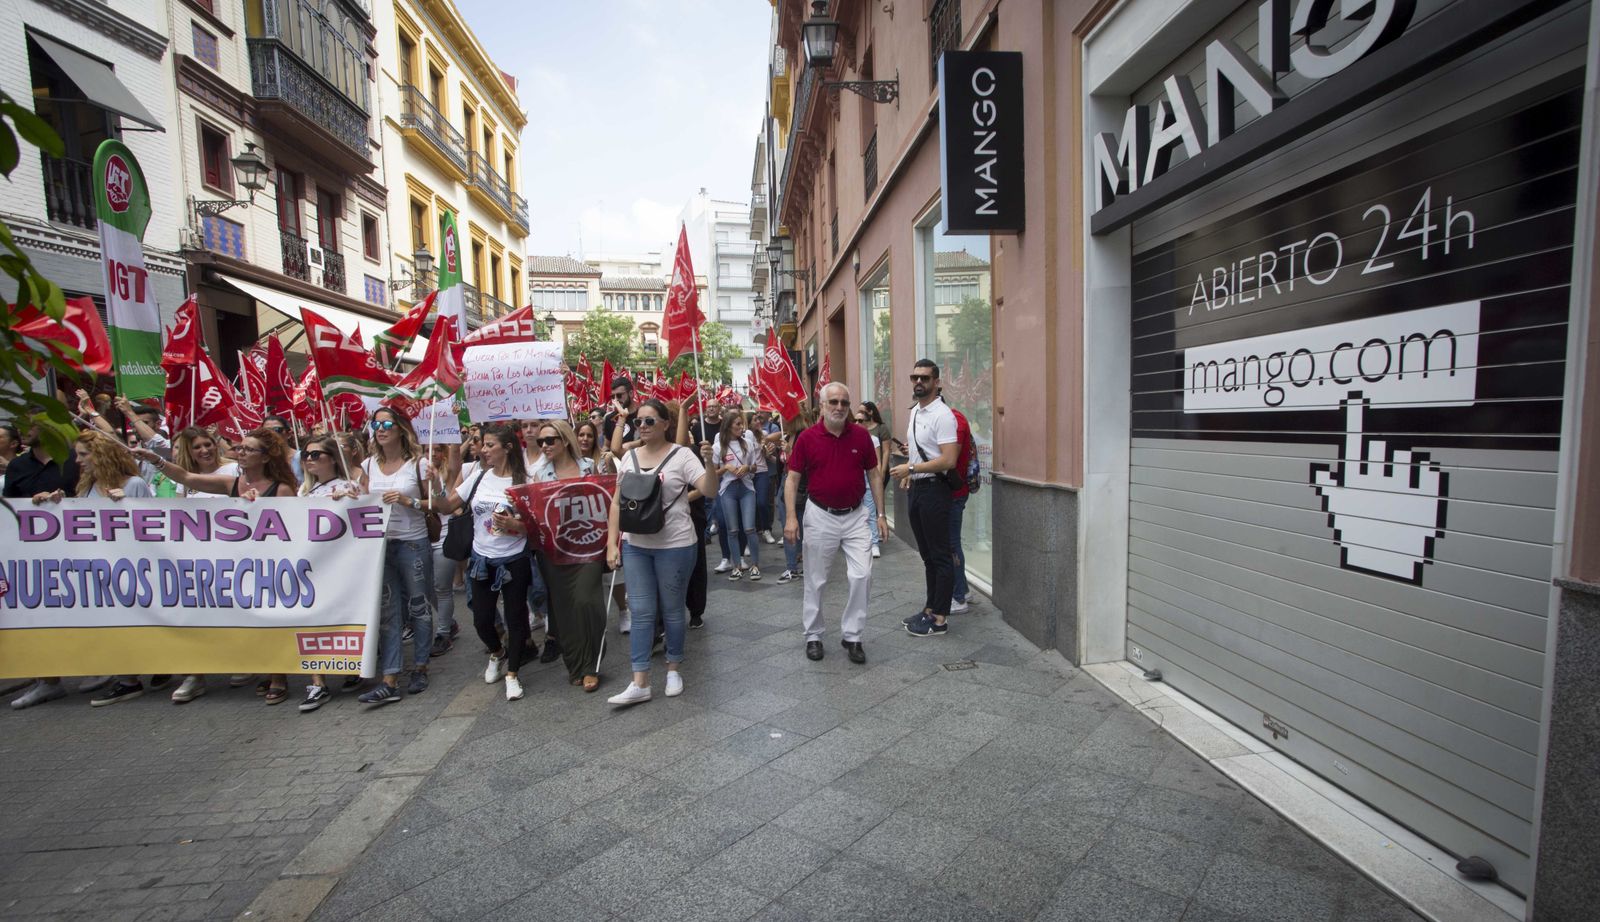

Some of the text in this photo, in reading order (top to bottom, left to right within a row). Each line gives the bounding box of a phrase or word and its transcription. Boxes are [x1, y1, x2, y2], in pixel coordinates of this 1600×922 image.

[971, 67, 998, 215] MANGO
[1189, 186, 1475, 316] ABIERTO 24h
[1191, 329, 1457, 407] mango.com
[18, 505, 385, 542] DEFENSA DE
[0, 558, 316, 609] NUESTROS DERECHOS
[301, 657, 363, 671] servicios
[302, 635, 360, 652] CCOO
